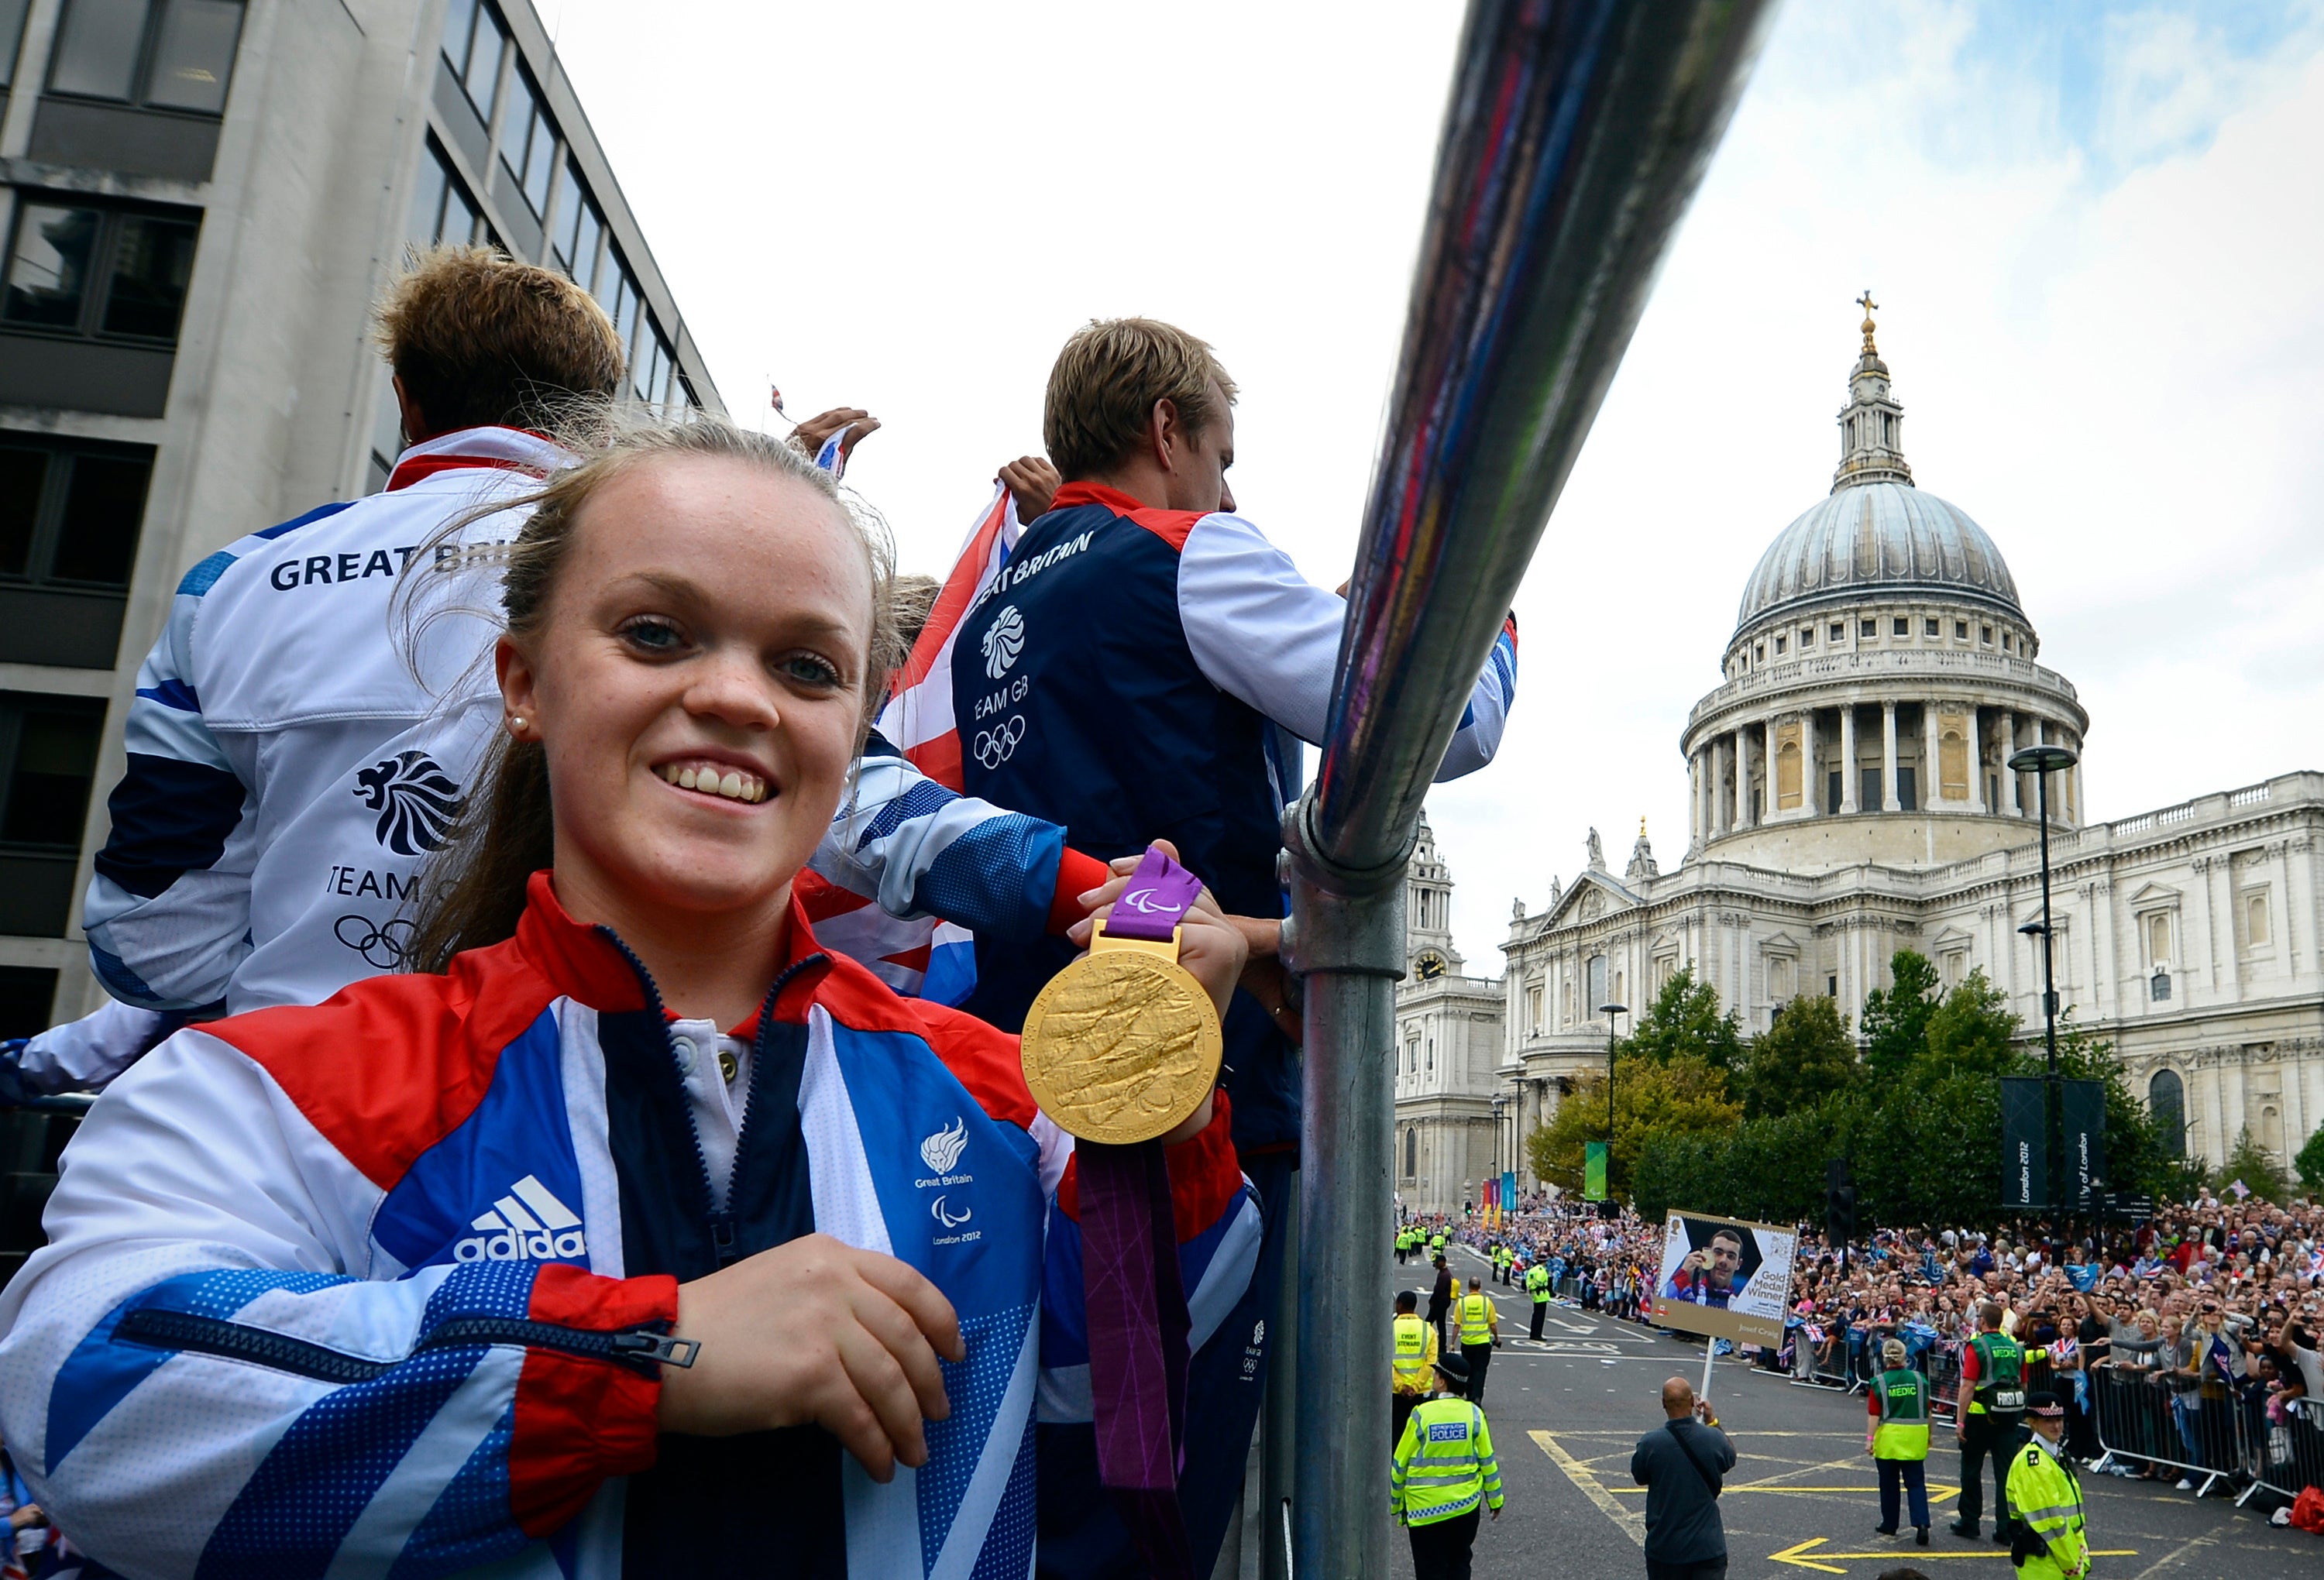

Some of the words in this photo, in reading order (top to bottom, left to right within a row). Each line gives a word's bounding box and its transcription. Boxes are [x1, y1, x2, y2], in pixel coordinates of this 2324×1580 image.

[1012, 531, 1095, 585] BRITAIN
[270, 545, 420, 592] GREAT
[435, 539, 511, 572] BRI
[975, 687, 1008, 721] EAM
[1011, 675, 1029, 702] GB
[2019, 1141, 2030, 1165] 2012
[2078, 1132, 2089, 1171] London
[915, 1177, 941, 1188] Great
[942, 1173, 974, 1187] Britain
[2020, 1166, 2030, 1204] London
[2078, 1172, 2089, 1185] of
[453, 1226, 586, 1264] adida
[933, 1235, 960, 1245] London
[961, 1231, 982, 1242] 2012
[1762, 1271, 1786, 1283] Gold
[1754, 1279, 1785, 1291] Medal
[1748, 1287, 1783, 1301] Winner
[1992, 1349, 2017, 1358] MEDIC
[1888, 1386, 1917, 1397] MEDIC
[1431, 1429, 1465, 1441] POLICE
